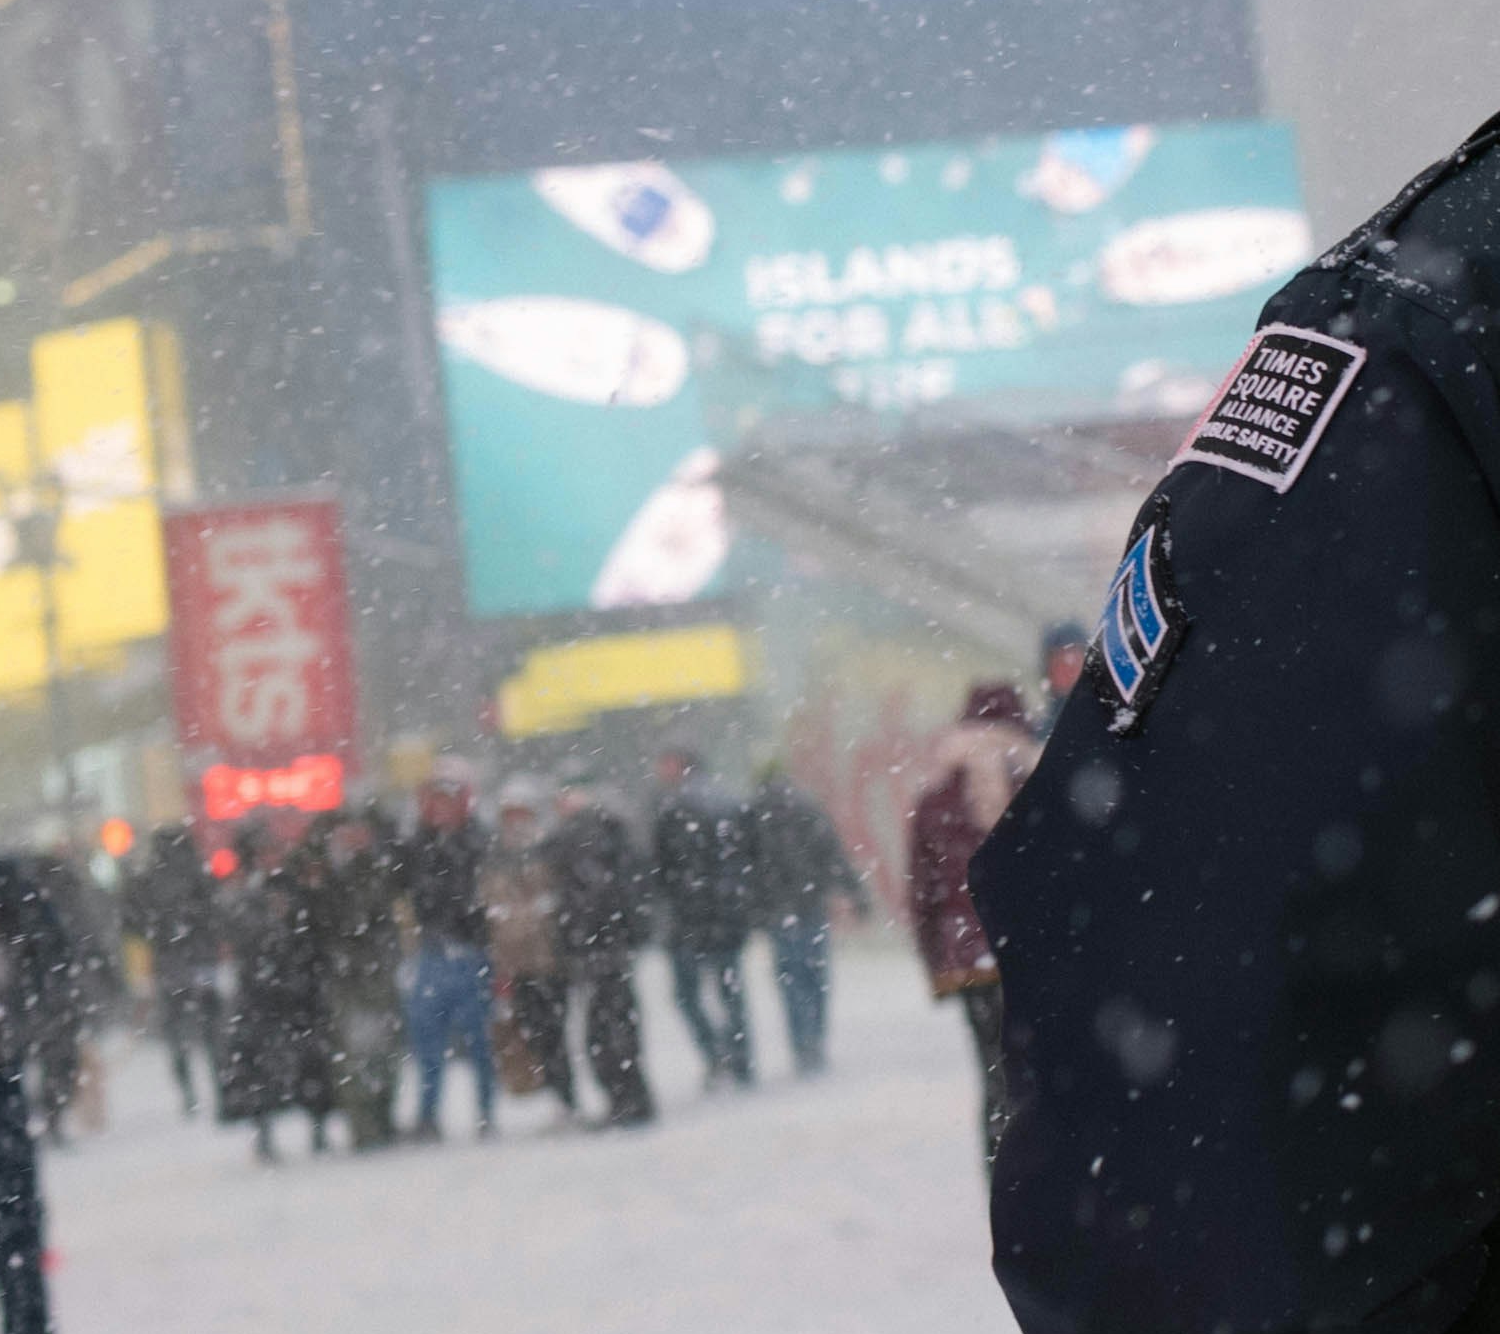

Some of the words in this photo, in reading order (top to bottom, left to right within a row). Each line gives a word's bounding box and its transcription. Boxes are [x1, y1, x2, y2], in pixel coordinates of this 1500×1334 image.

[1253, 347, 1328, 385] TIMES
[1230, 372, 1322, 416] SQUARE
[1218, 400, 1300, 437] ALLIANCE
[1235, 427, 1301, 464] SAFETY
